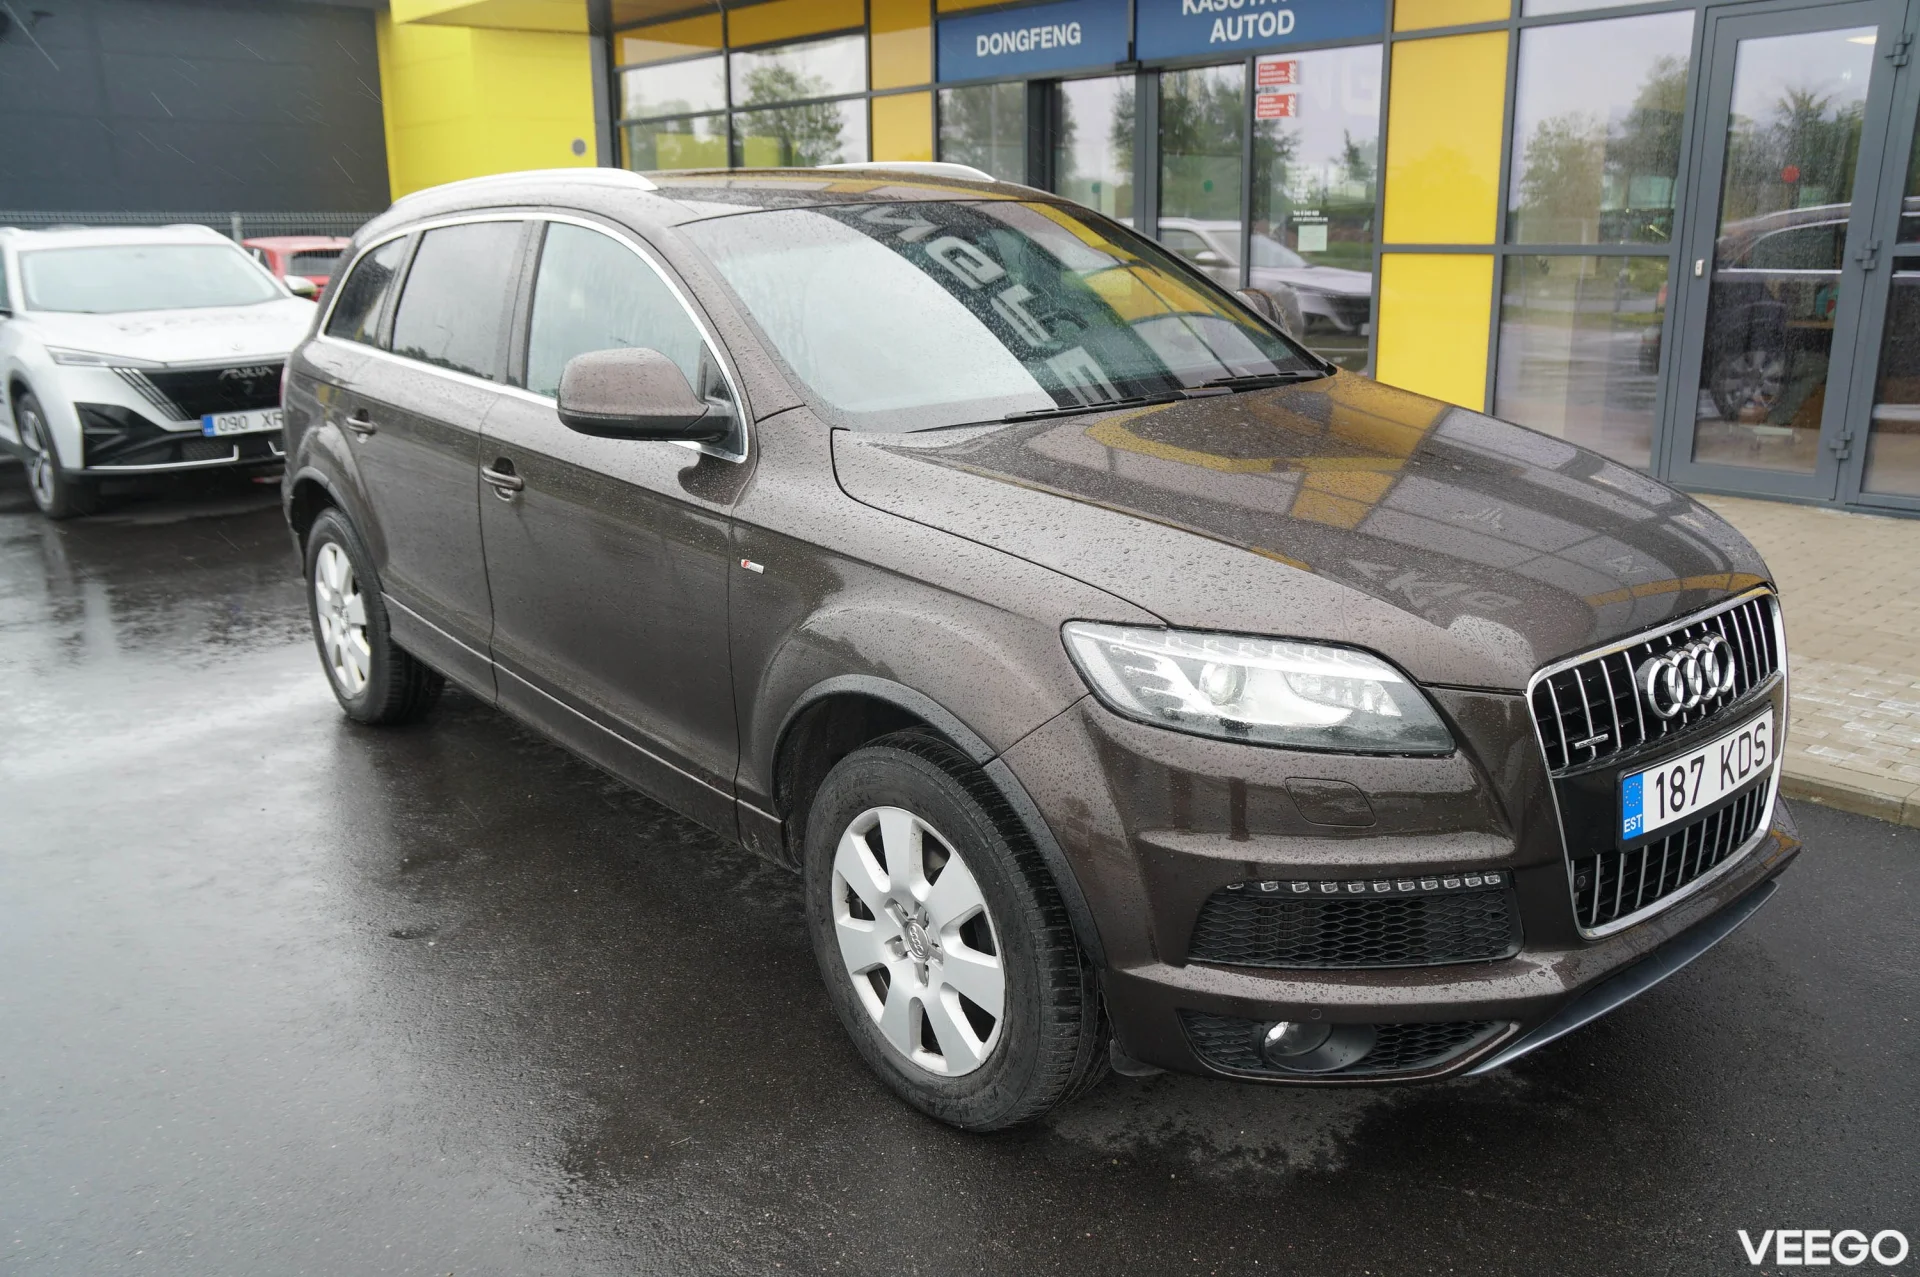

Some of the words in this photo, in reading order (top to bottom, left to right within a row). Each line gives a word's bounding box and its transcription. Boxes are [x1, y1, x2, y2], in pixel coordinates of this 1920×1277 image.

[976, 22, 1082, 57] DONGFENG
[1209, 9, 1295, 44] AUTOD
[218, 415, 249, 432] 090
[1655, 754, 1705, 820] 187
[1720, 721, 1767, 791] KDS
[1624, 814, 1643, 833] EST
